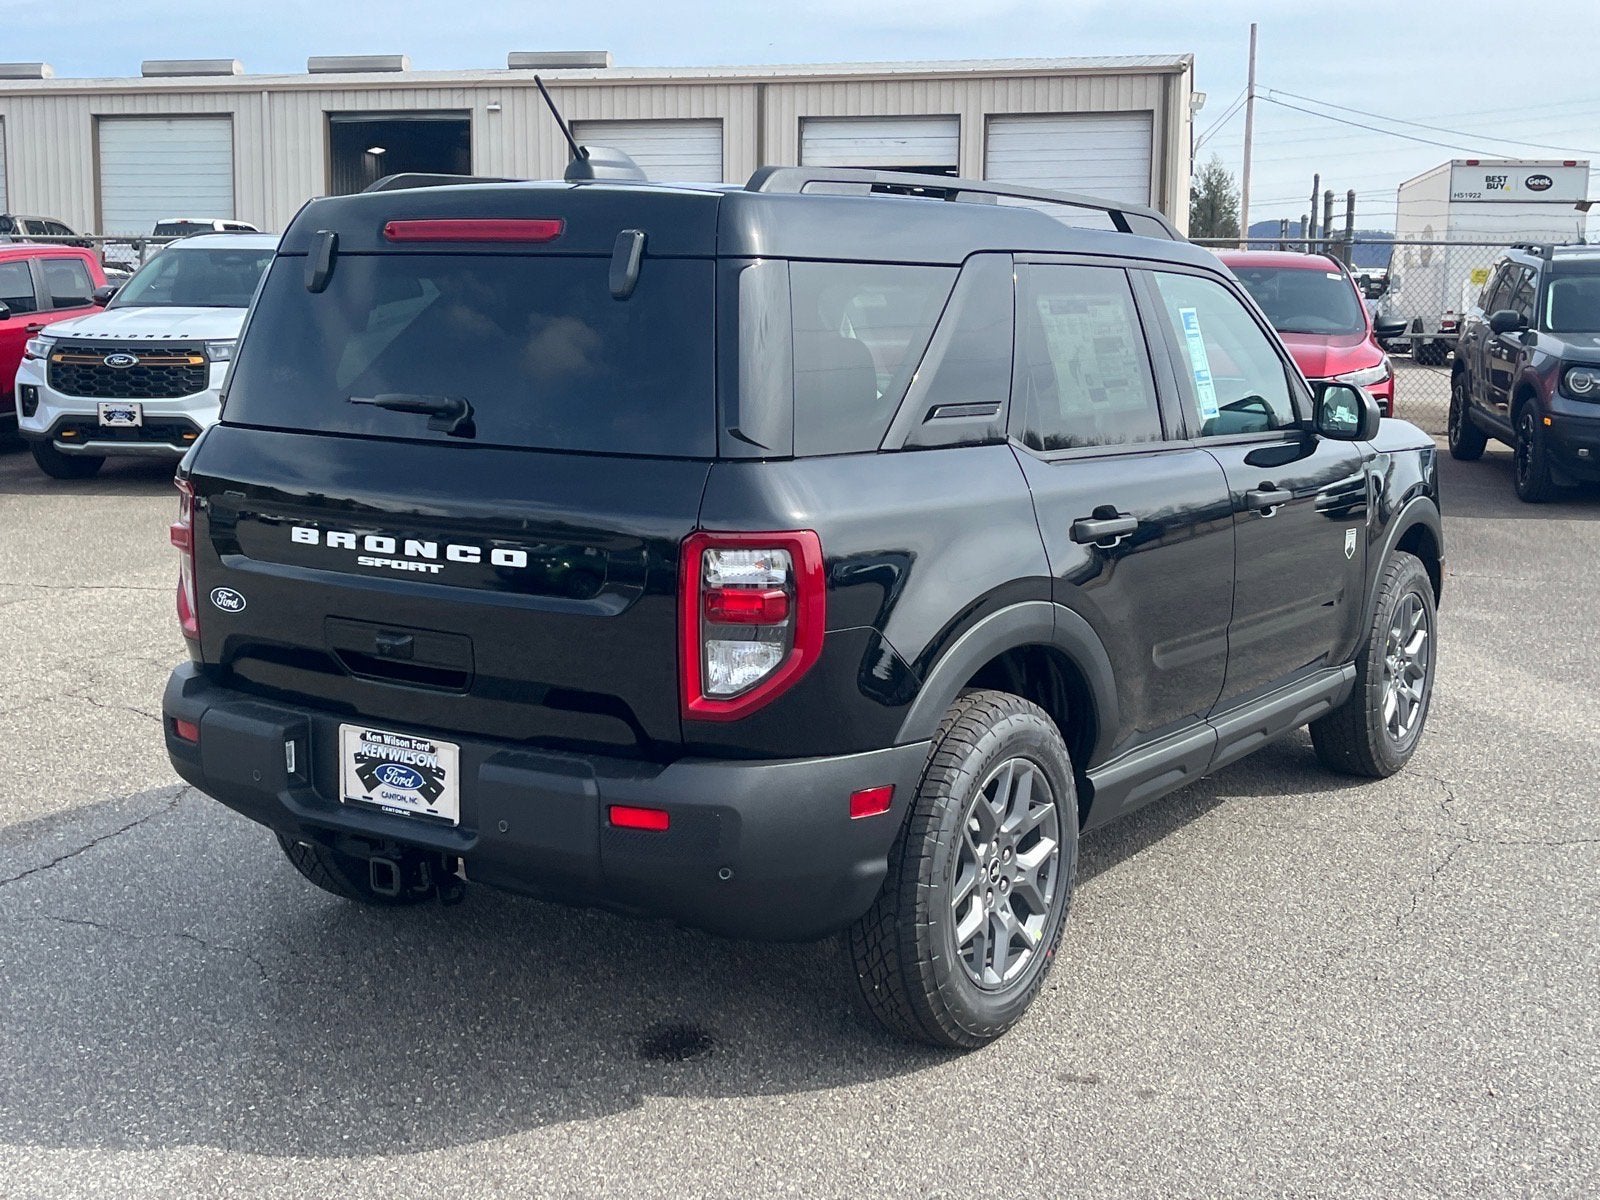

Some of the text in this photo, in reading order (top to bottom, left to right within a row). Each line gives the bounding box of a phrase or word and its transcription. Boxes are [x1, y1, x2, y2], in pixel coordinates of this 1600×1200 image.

[1485, 175, 1508, 183] BEST
[1527, 177, 1551, 186] Geek
[291, 526, 528, 568] BRONCO
[357, 556, 445, 574] SPORT
[216, 590, 239, 609] Ford
[366, 731, 430, 752] Ken Wilson Ford
[361, 742, 438, 769] KEN WILSON
[383, 766, 415, 788] Ford
[409, 796, 419, 804] NC
